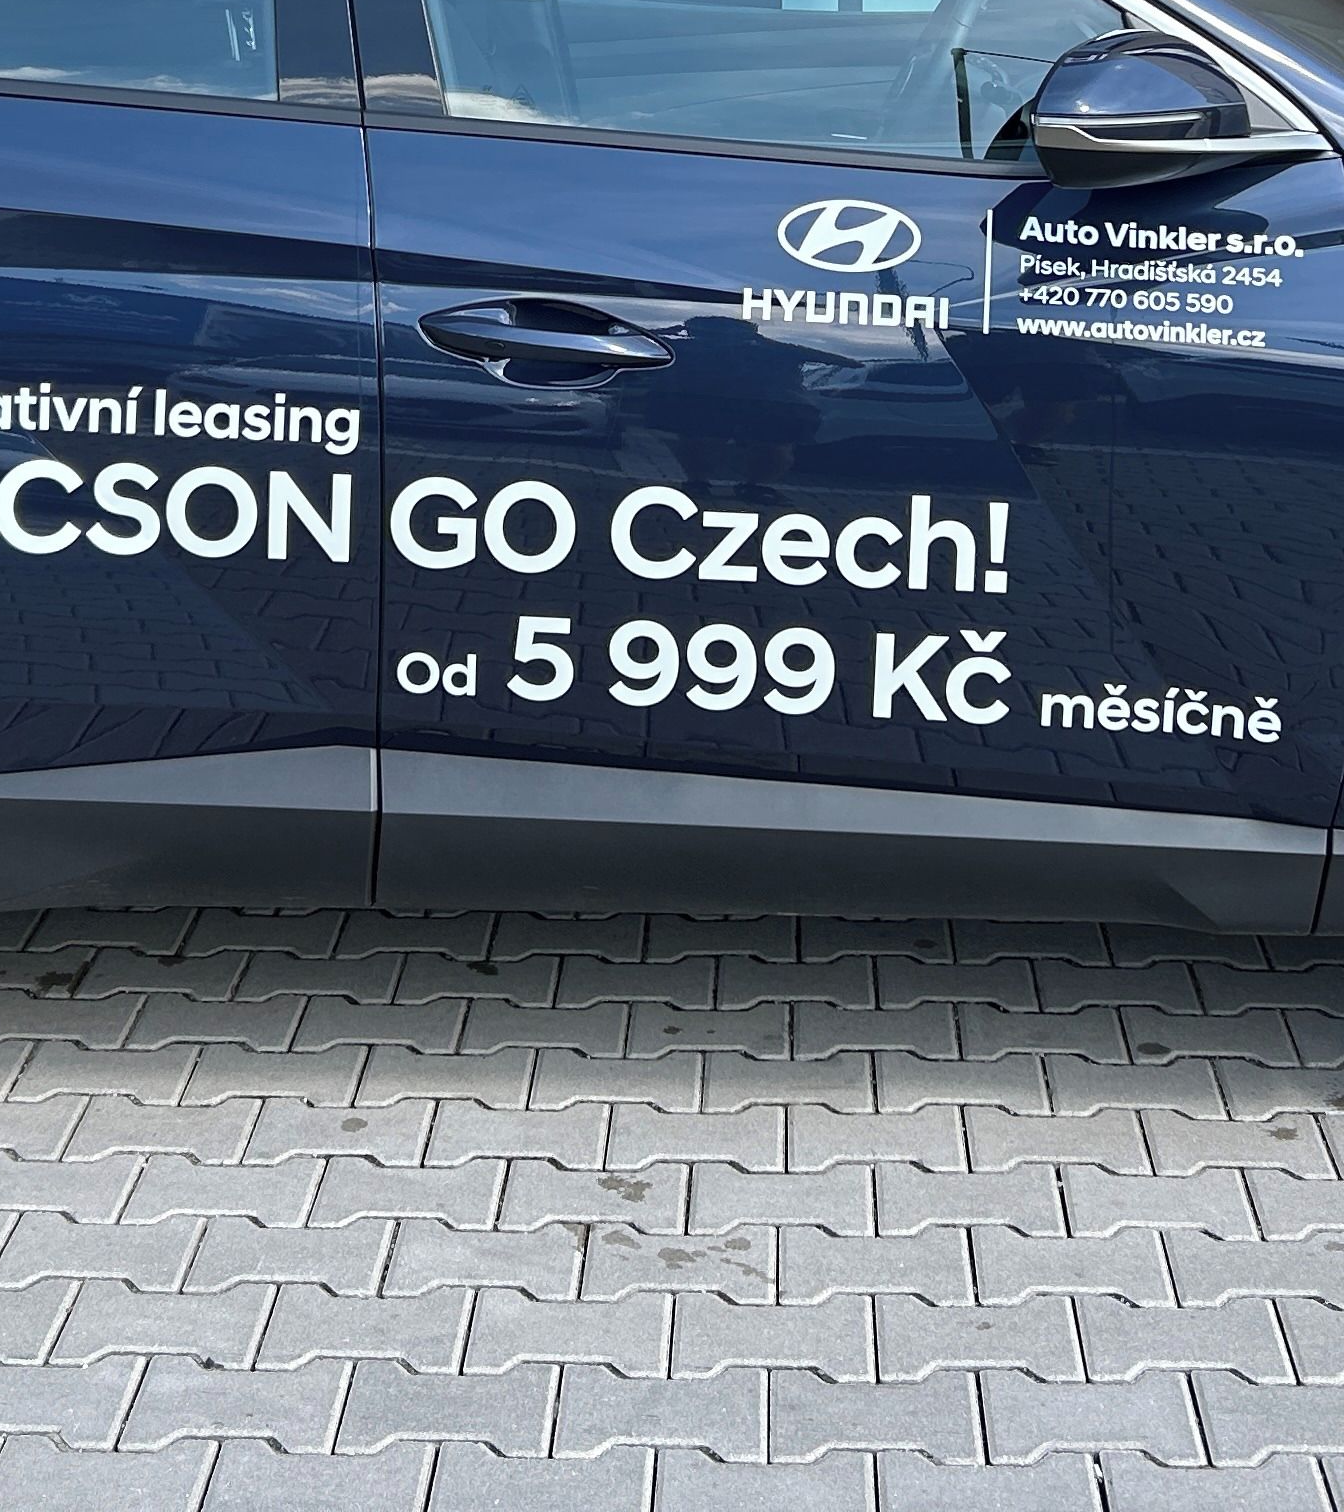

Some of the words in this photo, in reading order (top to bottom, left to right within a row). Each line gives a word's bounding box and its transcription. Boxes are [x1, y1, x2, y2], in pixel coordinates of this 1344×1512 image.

[1019, 216, 1099, 247] Auto
[1104, 221, 1222, 251] Vinkler
[1225, 233, 1304, 258] s.r.o.
[1020, 254, 1086, 280] Písek,
[1091, 259, 1216, 285] Hradišťská
[1221, 266, 1283, 288] 2454
[742, 287, 949, 329] HYUNDAI
[1018, 285, 1081, 306] +420
[1084, 288, 1128, 309] 770
[1133, 290, 1181, 312] 605
[1185, 293, 1234, 316] 590
[1016, 317, 1267, 349] www.autovinkler.cz
[154, 389, 360, 455] leasing
[389, 475, 577, 574] GO
[610, 485, 1009, 594] Czech!
[396, 651, 478, 697] Od
[505, 614, 575, 702] 5
[608, 619, 836, 715] 999
[871, 629, 1012, 725] Kč
[1039, 683, 1283, 743] měsíčně
